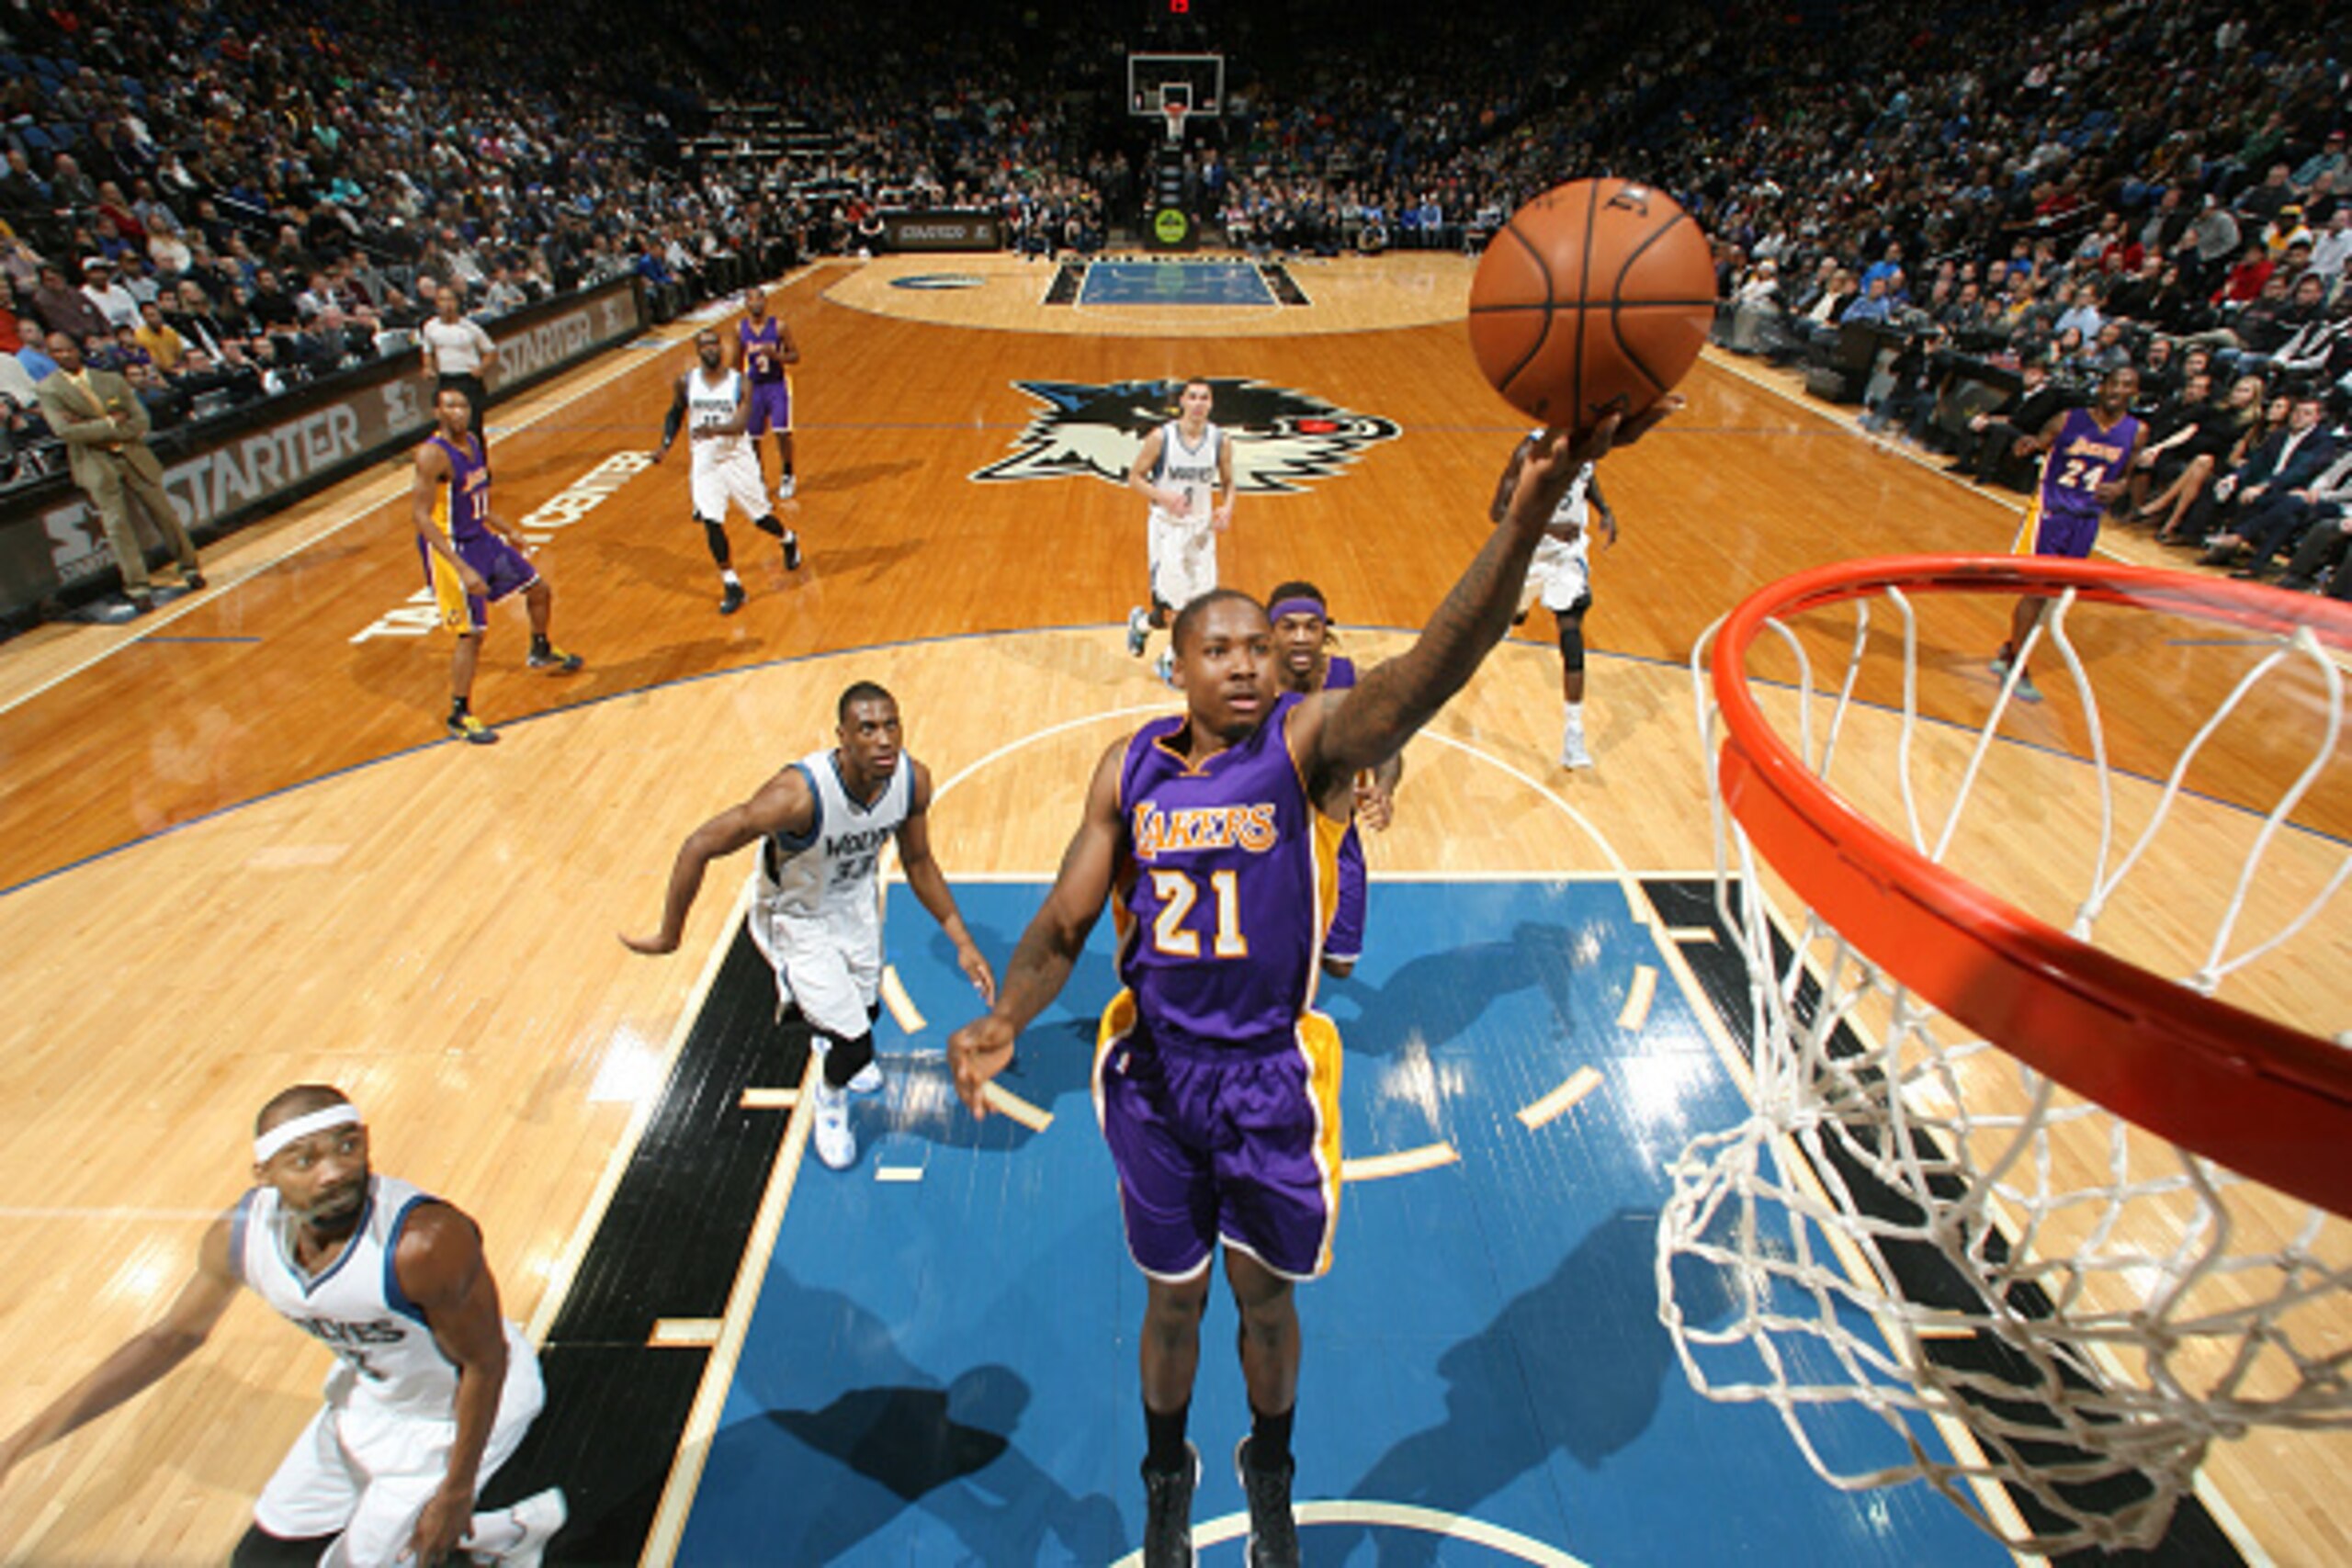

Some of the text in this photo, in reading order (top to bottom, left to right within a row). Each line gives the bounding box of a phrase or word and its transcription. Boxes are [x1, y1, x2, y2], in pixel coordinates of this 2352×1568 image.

[497, 310, 593, 387] STARTER
[161, 402, 362, 525] STARTER
[2057, 458, 2108, 492] 24
[1134, 801, 1279, 862] LAKERS
[1148, 868, 1249, 958] 21
